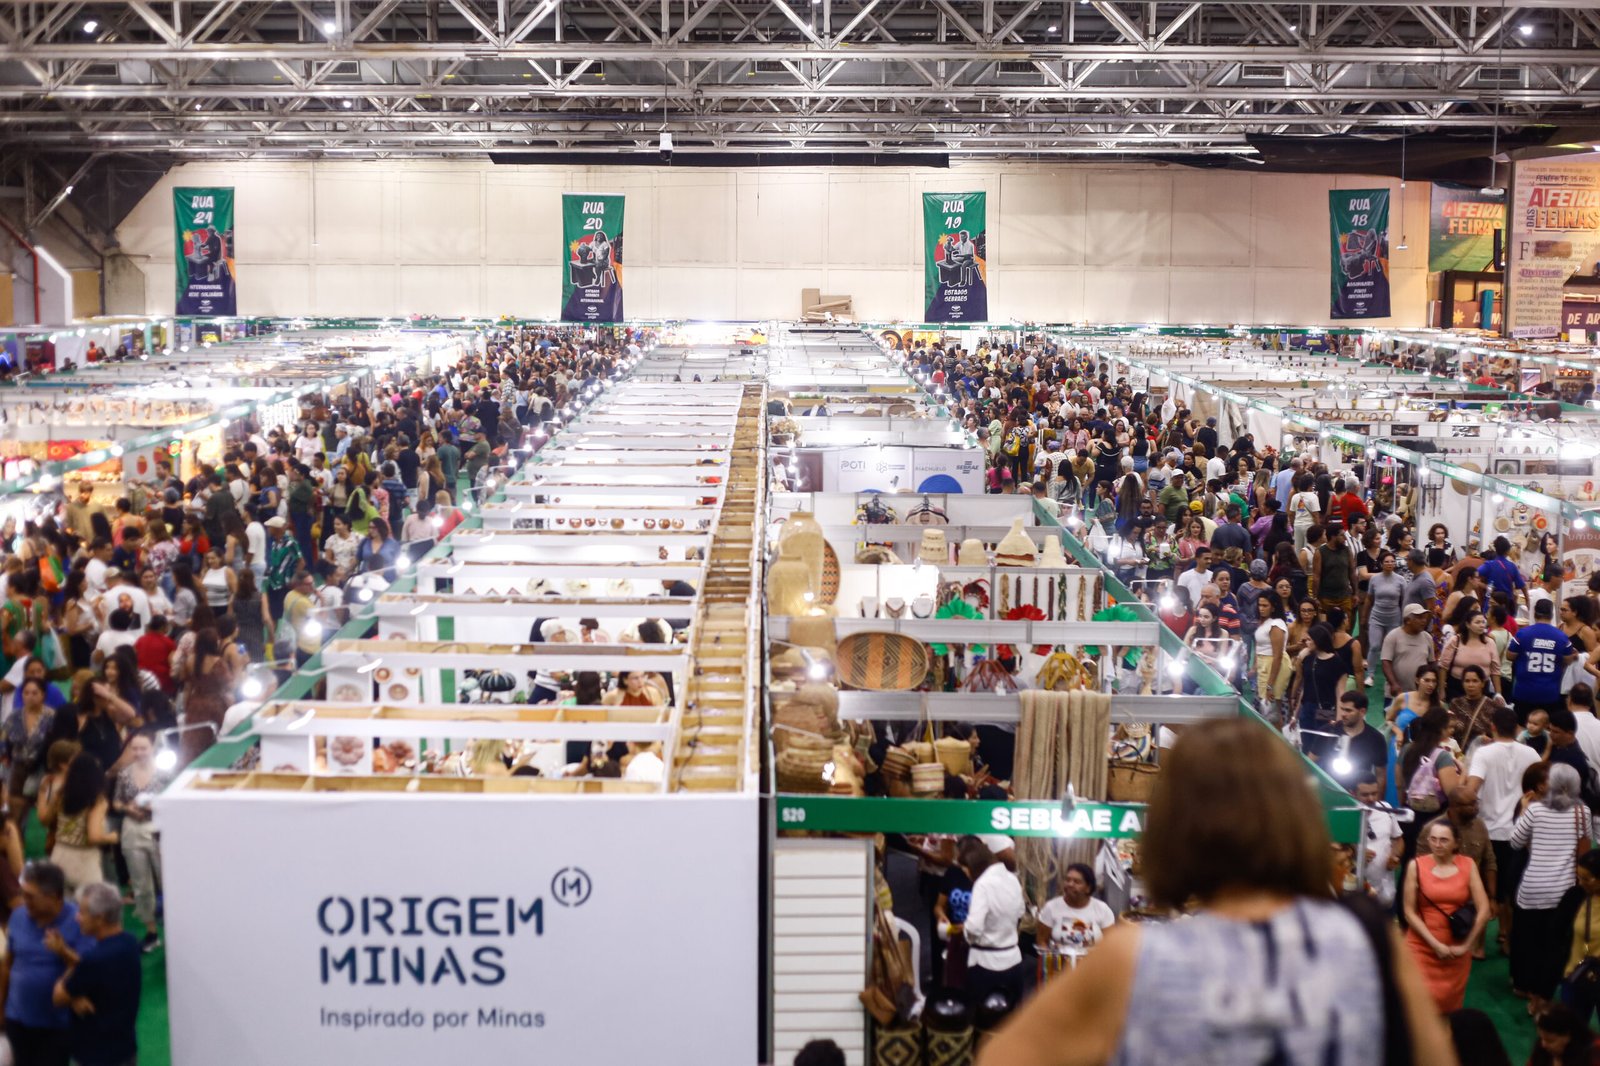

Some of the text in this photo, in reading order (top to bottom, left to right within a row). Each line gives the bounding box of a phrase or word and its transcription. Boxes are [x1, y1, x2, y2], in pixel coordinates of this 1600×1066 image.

[191, 195, 214, 208] RUA
[1349, 198, 1370, 211] RUA
[1528, 188, 1600, 208] A FEIRA
[582, 201, 605, 214] RUA
[942, 200, 965, 213] RUA
[193, 211, 213, 224] 21
[583, 217, 603, 230] 20
[945, 216, 962, 229] 19
[1351, 214, 1368, 226] 18
[1526, 208, 1536, 227] DAS
[1535, 208, 1600, 229] FEIRAS
[1567, 313, 1582, 325] DE
[317, 896, 544, 936] ORIGEM
[320, 946, 506, 986] MINAS
[320, 1006, 546, 1031] Inspirado por Minas
